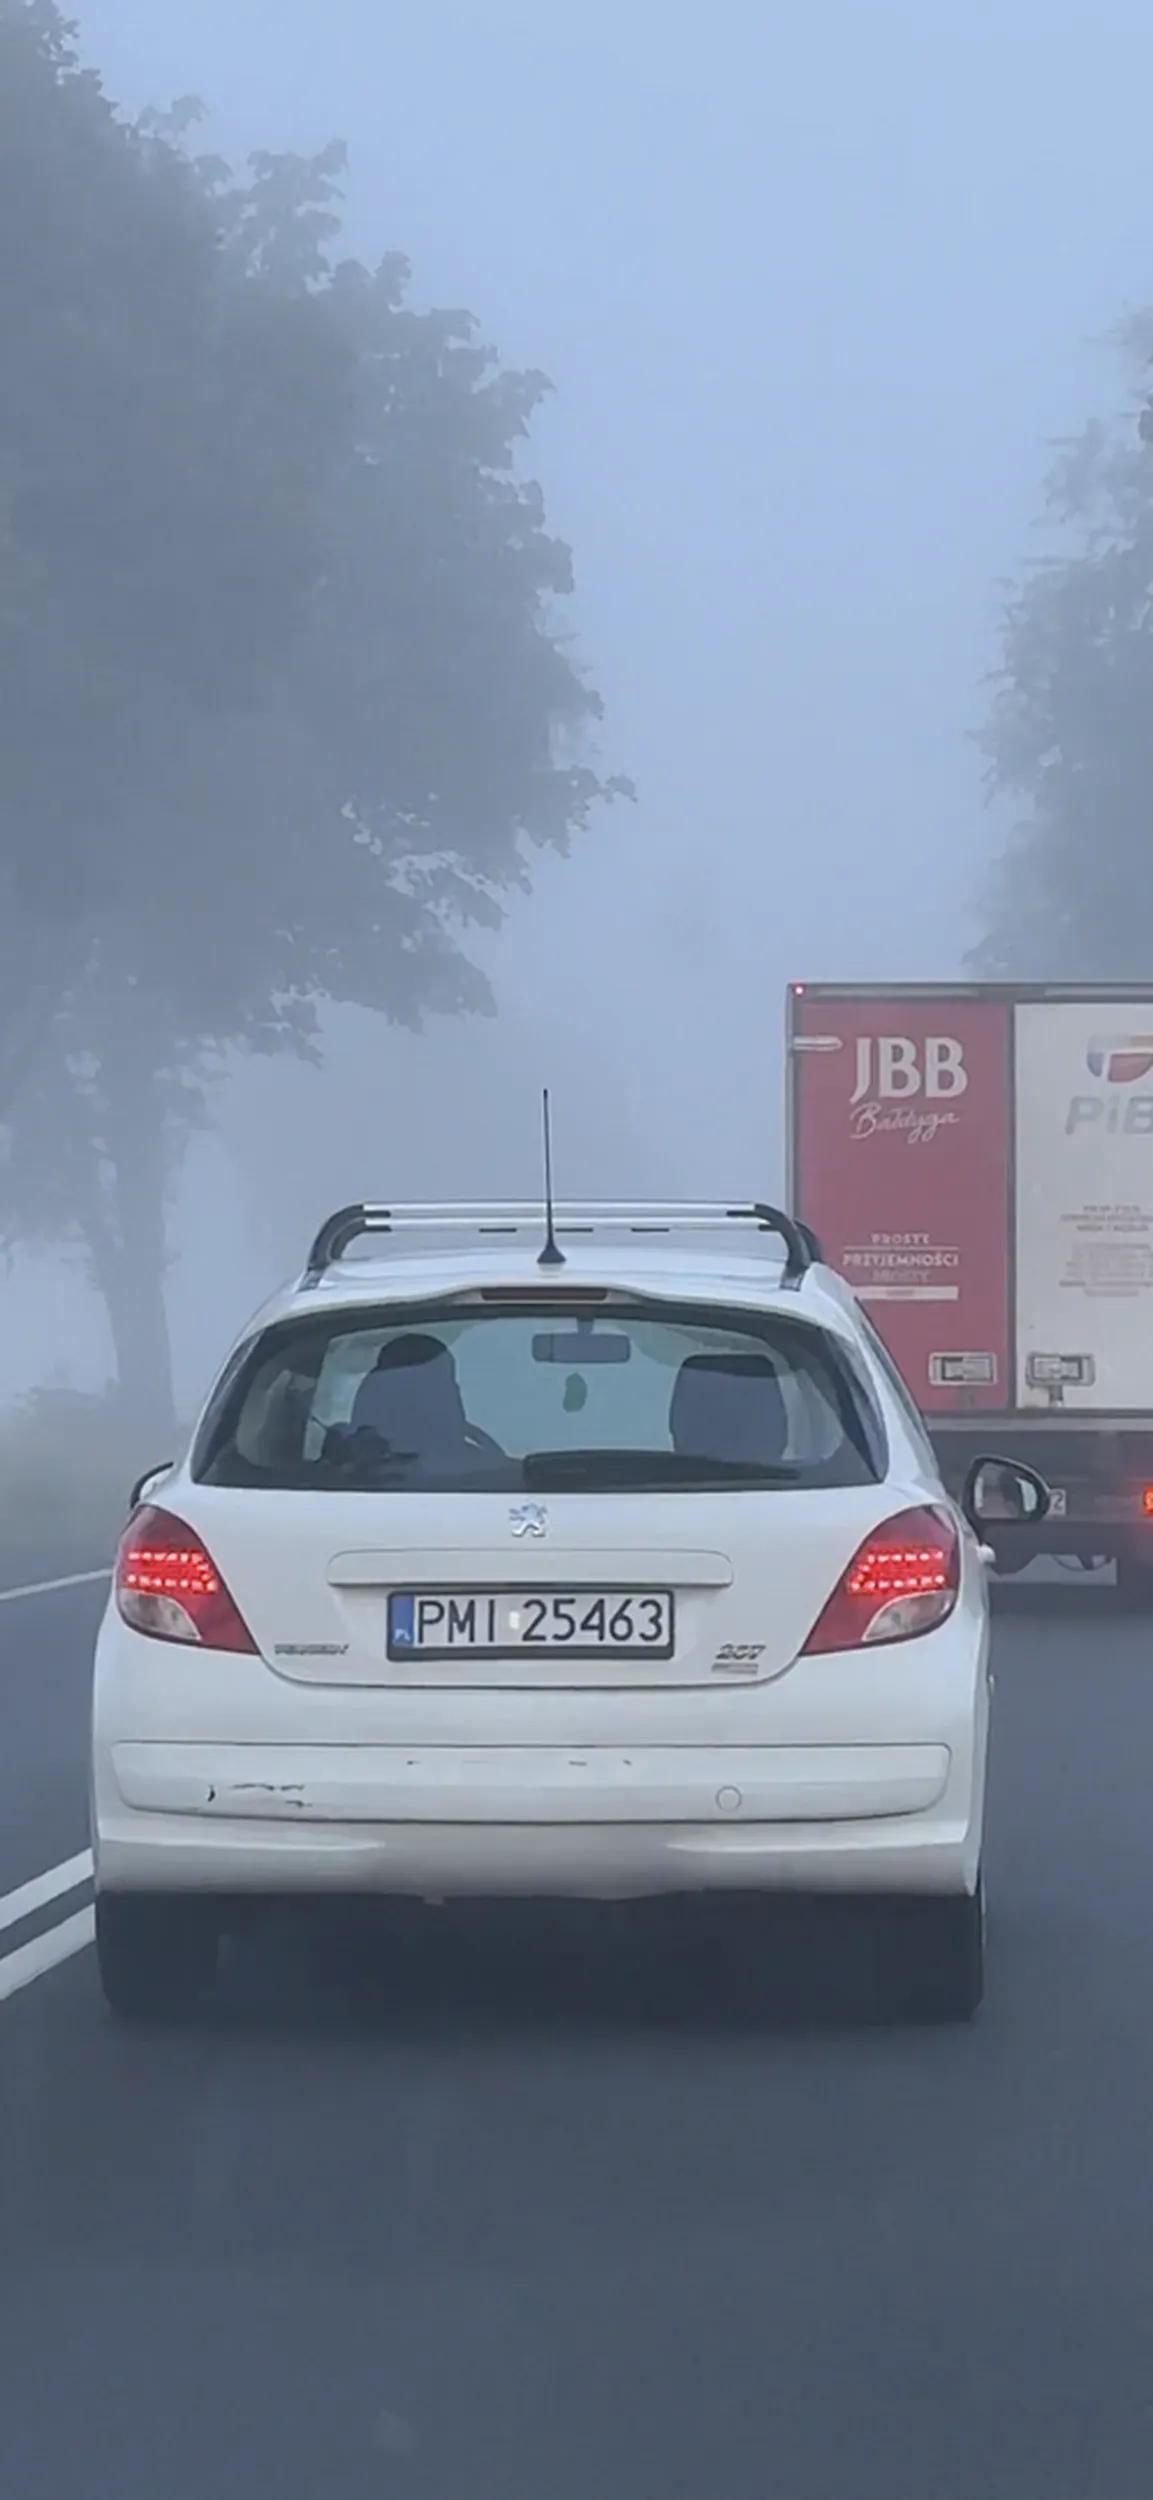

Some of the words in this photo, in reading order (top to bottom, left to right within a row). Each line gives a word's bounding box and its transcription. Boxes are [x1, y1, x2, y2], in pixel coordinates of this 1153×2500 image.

[849, 1036, 968, 1104] JBB
[418, 1600, 495, 1644] PMI
[521, 1598, 663, 1642] 25463
